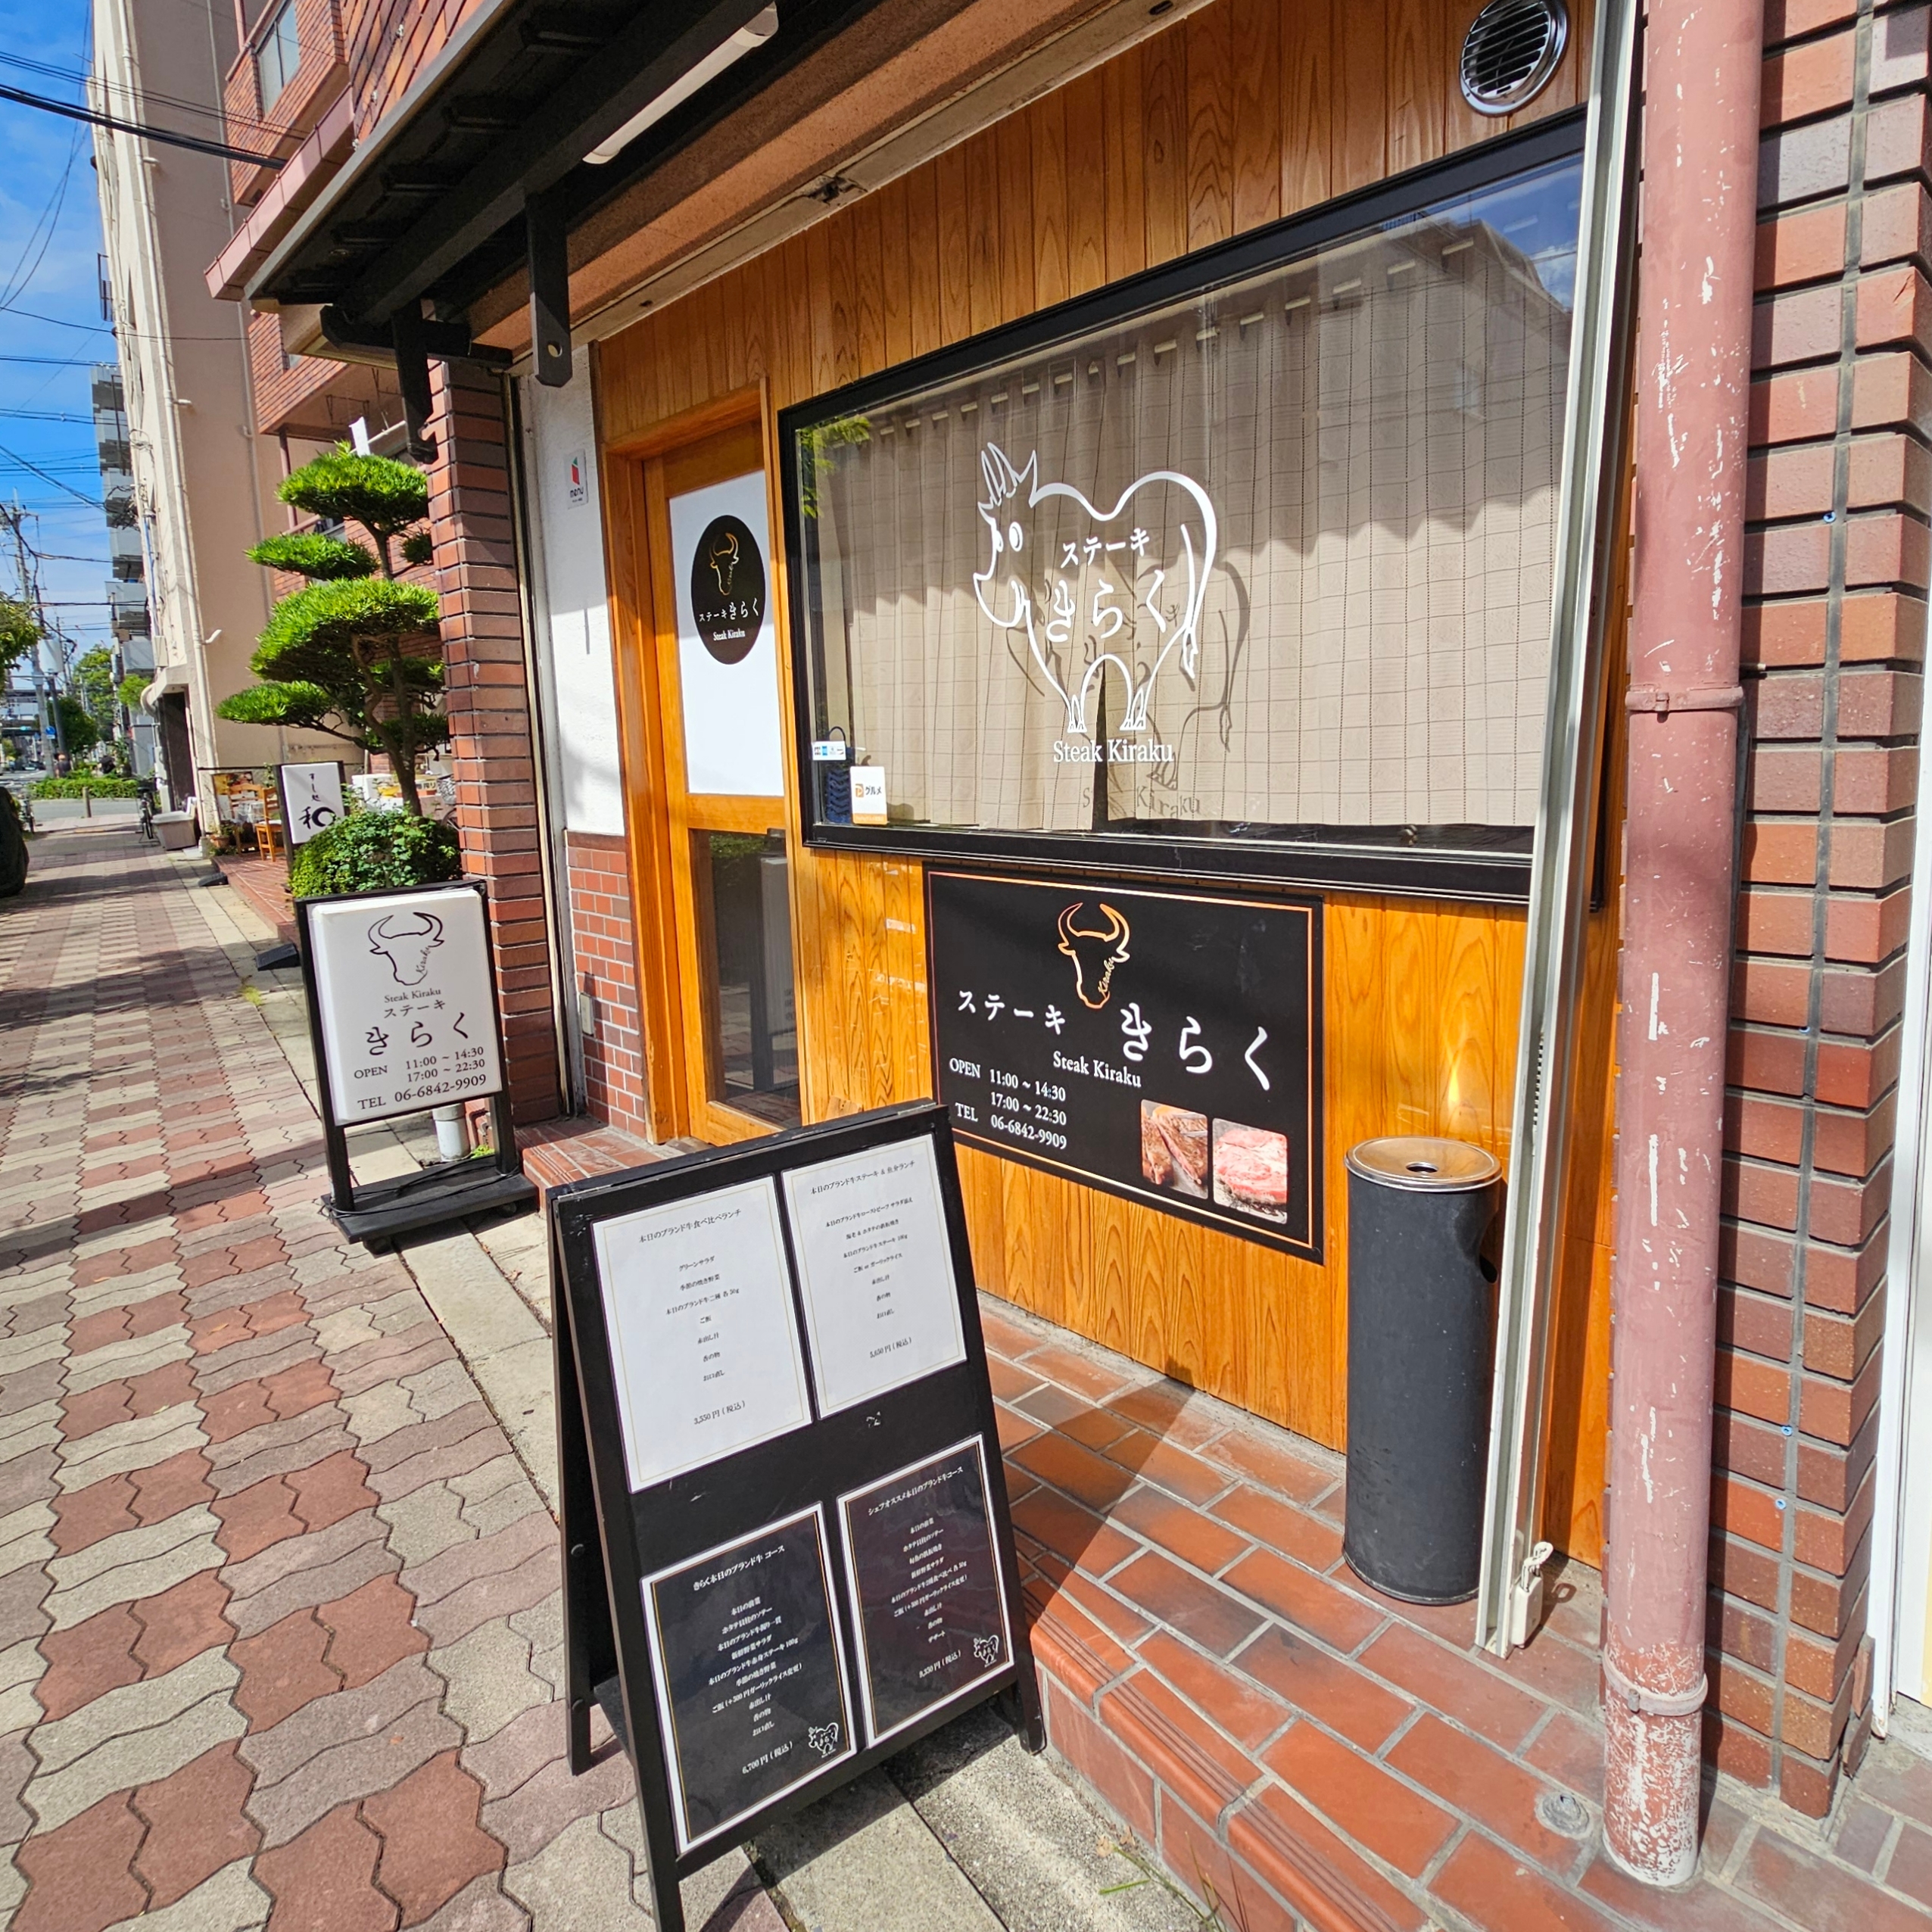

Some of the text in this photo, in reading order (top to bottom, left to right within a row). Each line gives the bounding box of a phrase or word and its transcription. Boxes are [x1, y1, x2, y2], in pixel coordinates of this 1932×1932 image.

[1061, 528, 1150, 569] ステーキ
[699, 597, 759, 622] ステーキ きらく
[1046, 569, 1166, 642] きらく
[713, 628, 746, 641] Steak Kiraku
[1053, 738, 1174, 763] Steak Kiraku
[865, 785, 883, 796] グルメ
[384, 988, 441, 1003] Steak Kiraku
[384, 999, 446, 1018] ステーキ
[365, 1012, 469, 1055] きらく
[958, 990, 1270, 1091] ステーキ きらく
[354, 1065, 388, 1080] OPEN
[406, 1055, 437, 1070] 11:00
[455, 1046, 484, 1061] 14:30
[407, 1068, 438, 1083] 17:00
[456, 1058, 485, 1073] 22:30
[1053, 1049, 1142, 1088] Steak Kiraku
[357, 1074, 486, 1110] TEL 06-6842-9909
[949, 1057, 980, 1078] OPEN
[989, 1069, 1018, 1089] 11:00
[1035, 1081, 1066, 1102] 14:30
[991, 1092, 1020, 1111] 17:00
[1035, 1105, 1067, 1126] 22:30
[955, 1102, 1067, 1149] TEL 06-6842-9909
[639, 1208, 741, 1243] 本日のブランド牛食べ比べランチ
[679, 1255, 715, 1272] グリーンサラダ
